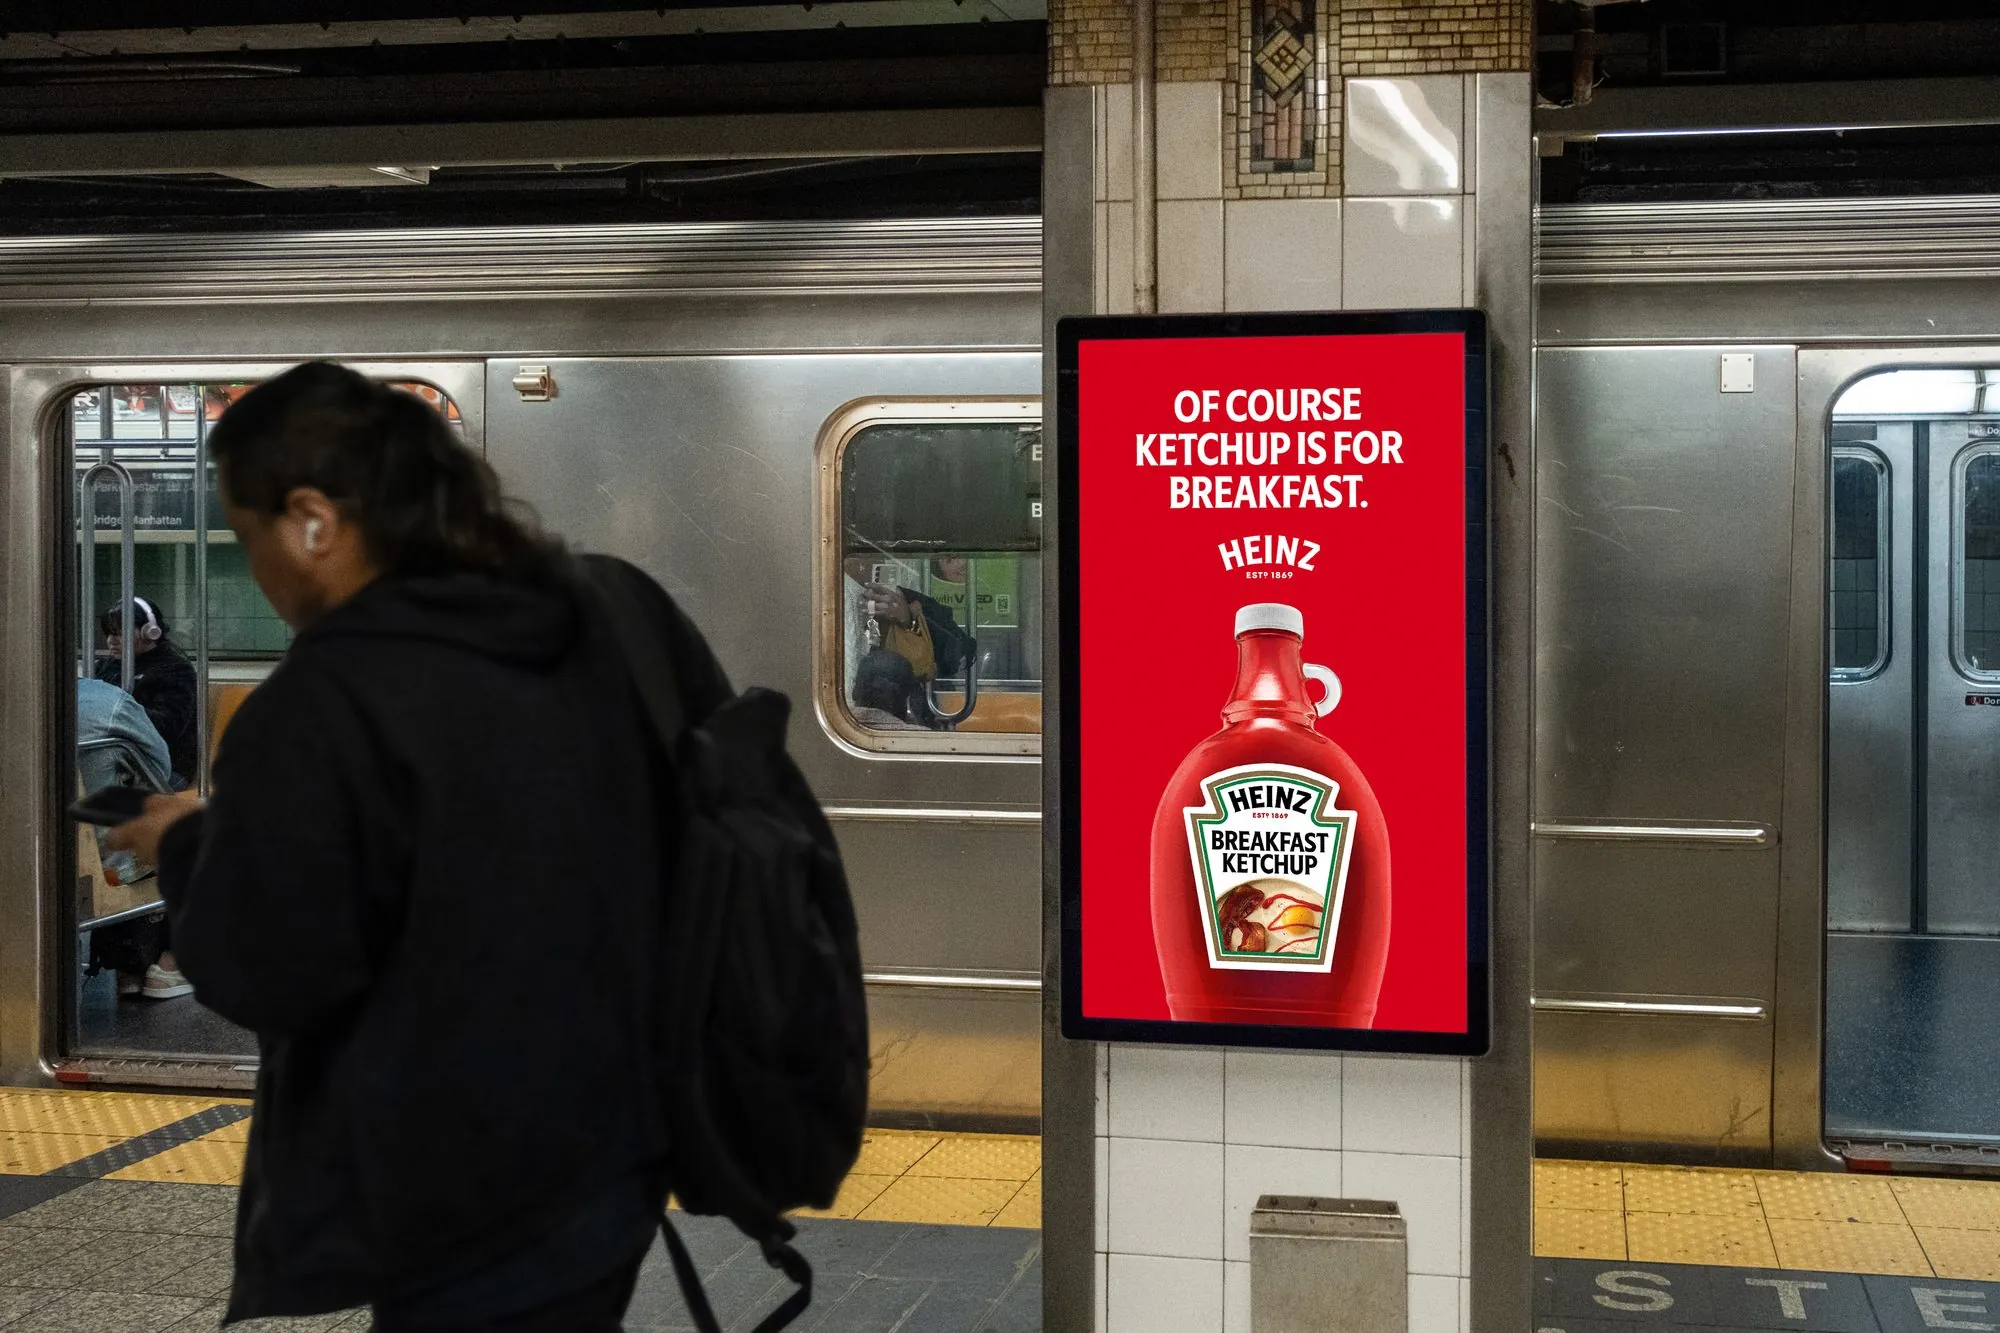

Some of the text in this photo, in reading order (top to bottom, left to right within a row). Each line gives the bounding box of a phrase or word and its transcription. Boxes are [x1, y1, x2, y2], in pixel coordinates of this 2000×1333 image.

[1174, 387, 1362, 423] OF COURSE
[1135, 430, 1404, 466] KETCHUP IS FOR
[1169, 474, 1369, 509] BREAKFAST.
[1217, 534, 1321, 571] HEINZ
[1271, 571, 1293, 579] 1869
[1228, 785, 1312, 815] HEINZ
[1211, 829, 1329, 853] BREAKFAST
[1222, 853, 1318, 876] KETCHUP
